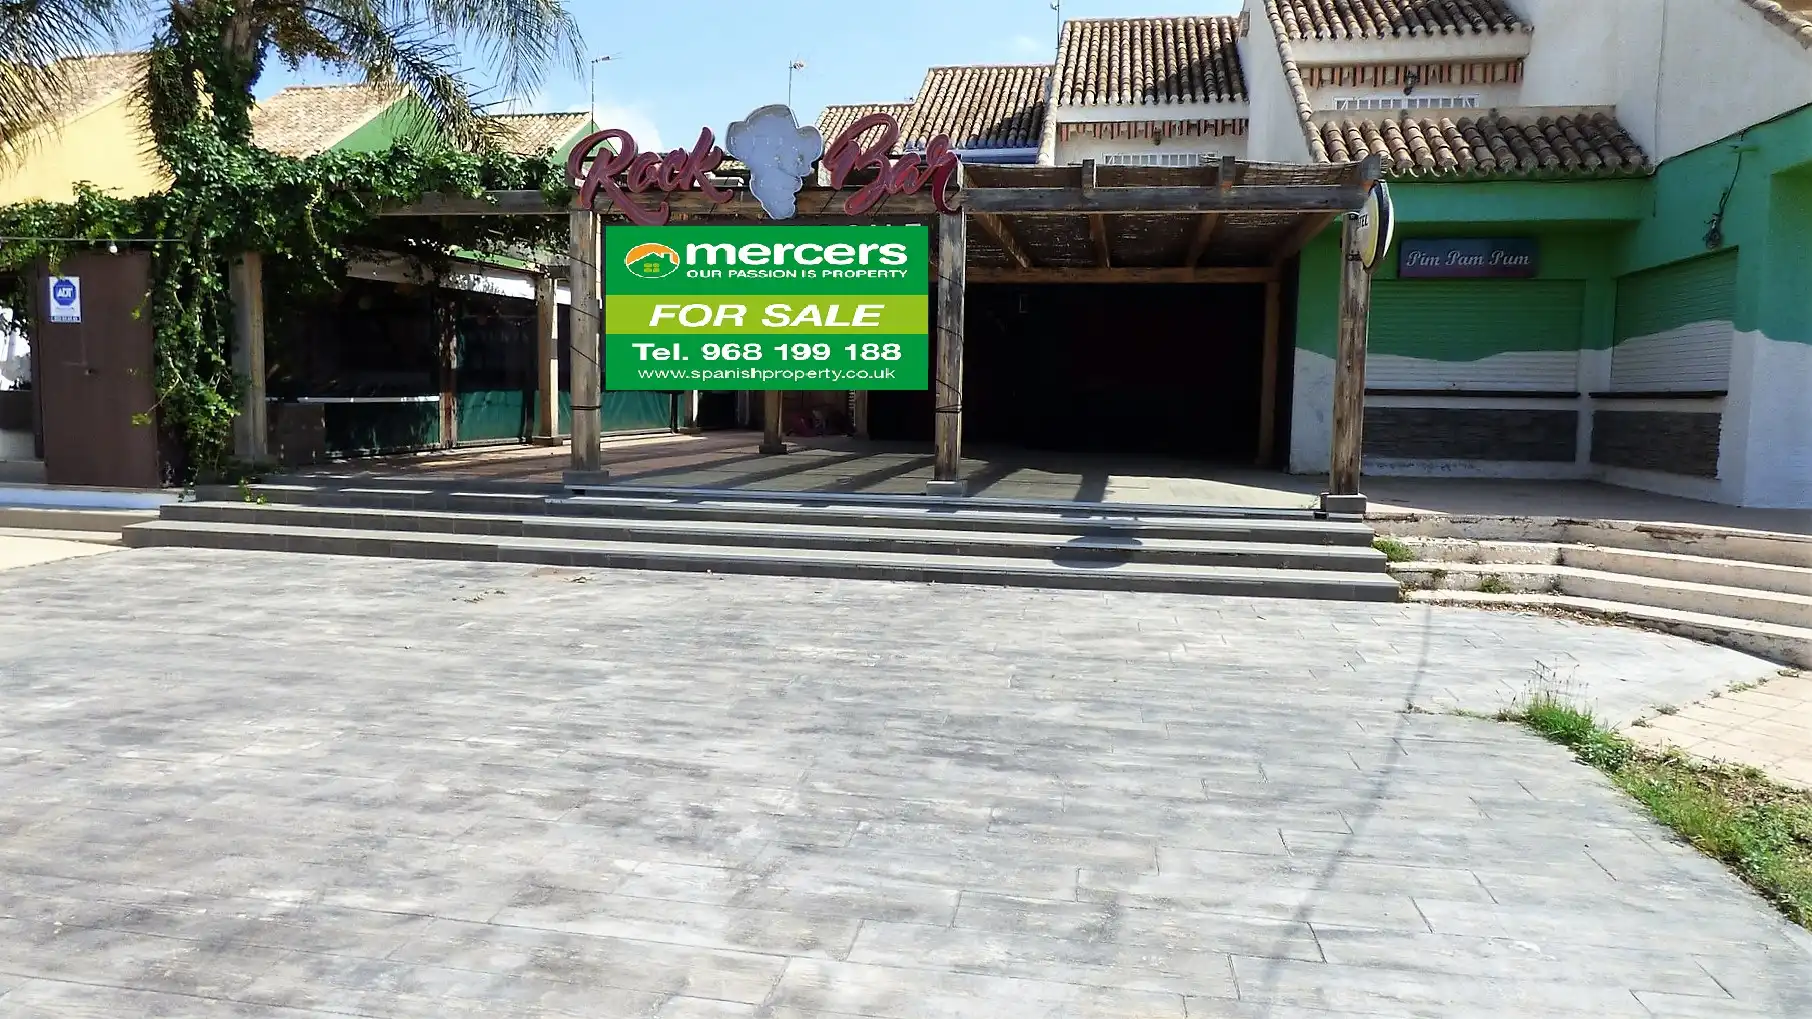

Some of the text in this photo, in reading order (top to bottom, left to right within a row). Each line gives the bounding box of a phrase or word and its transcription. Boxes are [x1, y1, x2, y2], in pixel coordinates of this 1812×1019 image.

[567, 112, 963, 227] Rock Bar
[1406, 249, 1531, 267] Pim Pam Pum
[57, 287, 74, 298] ADT
